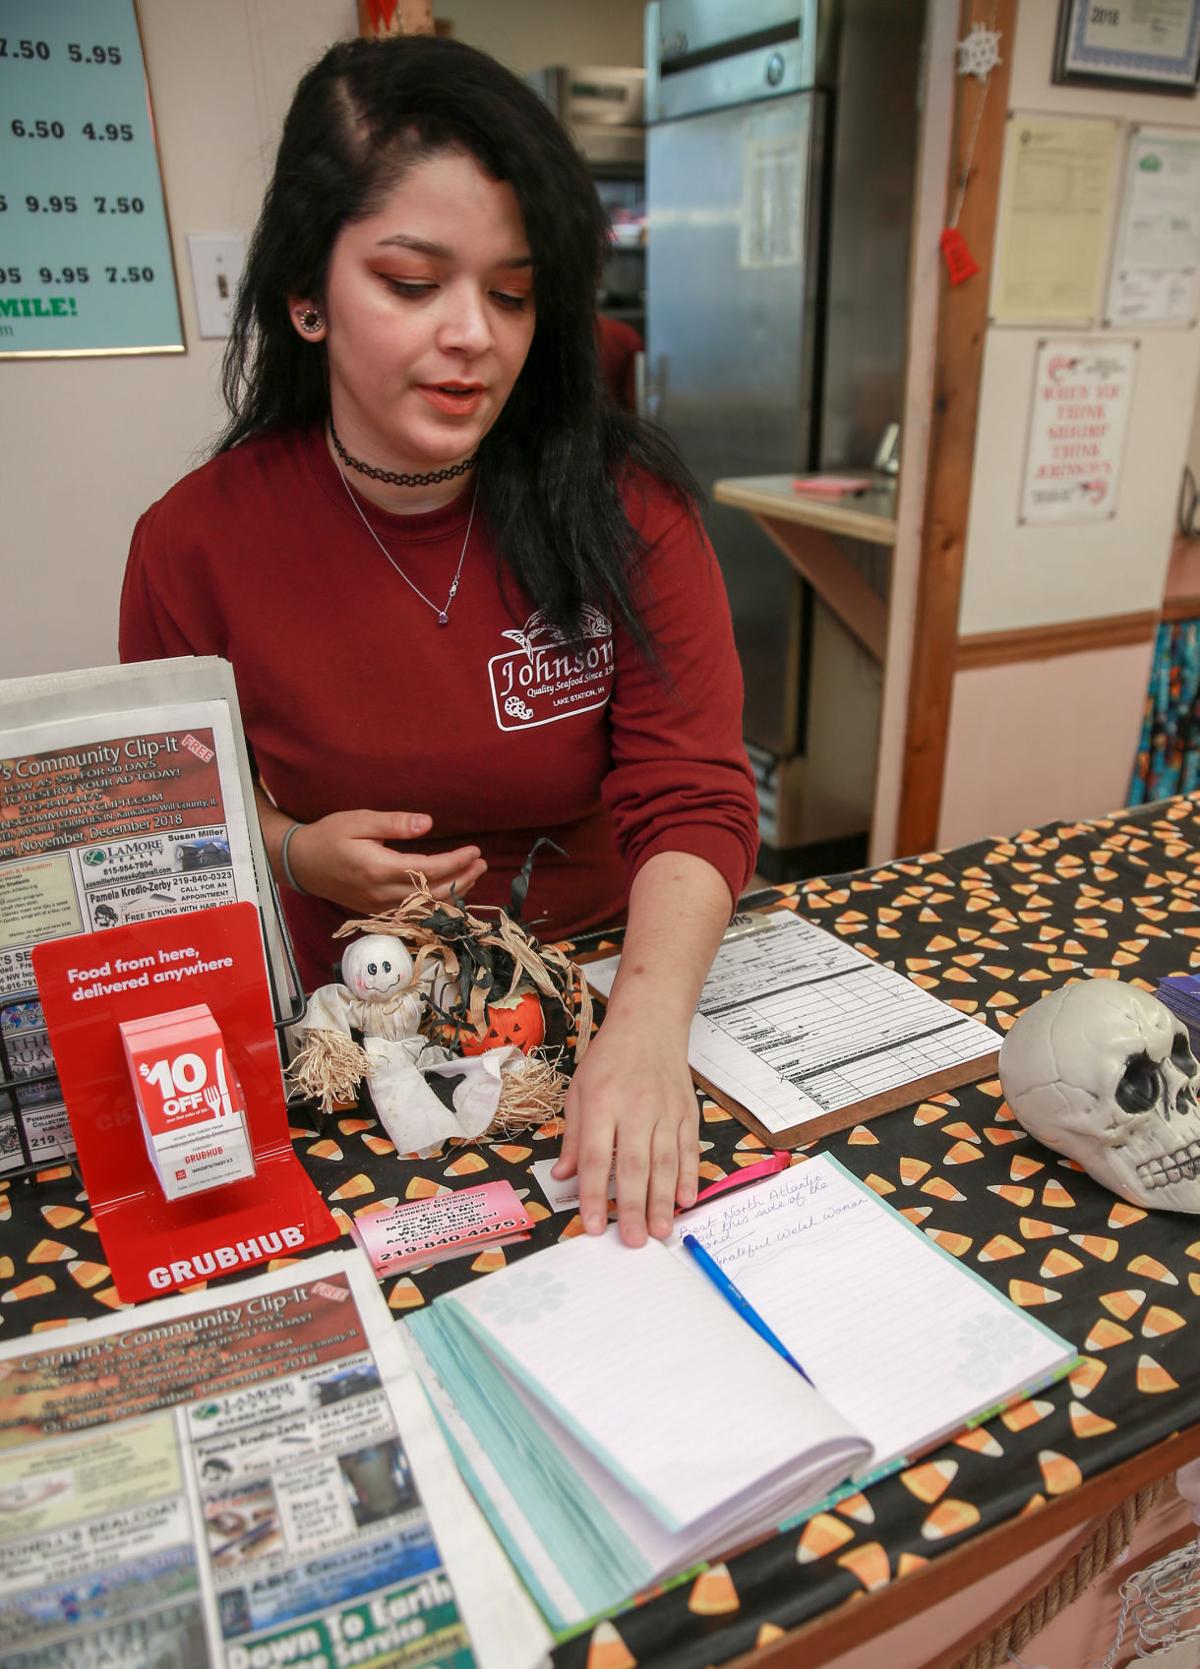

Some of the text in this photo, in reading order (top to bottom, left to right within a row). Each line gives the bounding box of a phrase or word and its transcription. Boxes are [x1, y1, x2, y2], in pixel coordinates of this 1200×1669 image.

[1091, 5, 1120, 27] 2018
[67, 43, 122, 65] 5.95
[11, 119, 134, 142] 6.50 4.95
[26, 196, 145, 214] 9.95 7.50
[39, 267, 155, 284] 9.95 7.50
[527, 685, 555, 698] Quality
[555, 674, 583, 692] Seafood
[584, 672, 603, 684] Since
[553, 696, 570, 707] LAKE
[16, 746, 120, 777] Community
[124, 736, 179, 759] Clip-It
[183, 735, 213, 761] FREE
[78, 779, 113, 791] YOUR
[138, 767, 181, 780] TODAY!
[80, 768, 105, 779] FOR
[107, 765, 122, 774] 90
[125, 759, 157, 772] DAYS
[21, 813, 184, 852] November, December 2018
[168, 828, 224, 842] Susan Miller
[109, 850, 164, 864] REALTY
[172, 871, 232, 886] 219-840-0323
[180, 885, 198, 893] CALL
[90, 889, 120, 904] Pamela
[181, 889, 229, 902] APPOINTMENT
[125, 910, 145, 922] FREE
[147, 907, 178, 918] STYLING
[180, 903, 198, 913] WITH
[68, 946, 200, 983] Food from here,
[72, 957, 233, 1002] delivered anywhere
[139, 1053, 208, 1100] $10
[163, 1091, 204, 1116] OFF
[31, 1135, 55, 1147] 219
[185, 1146, 224, 1165] GRUBHUB
[724, 1194, 764, 1219] North
[380, 1220, 516, 1262] 219-840-4475
[148, 1226, 305, 1289] GRUBHUB
[119, 1307, 242, 1349] Community
[247, 1287, 310, 1316] Clip-It
[282, 1352, 319, 1373] 2018
